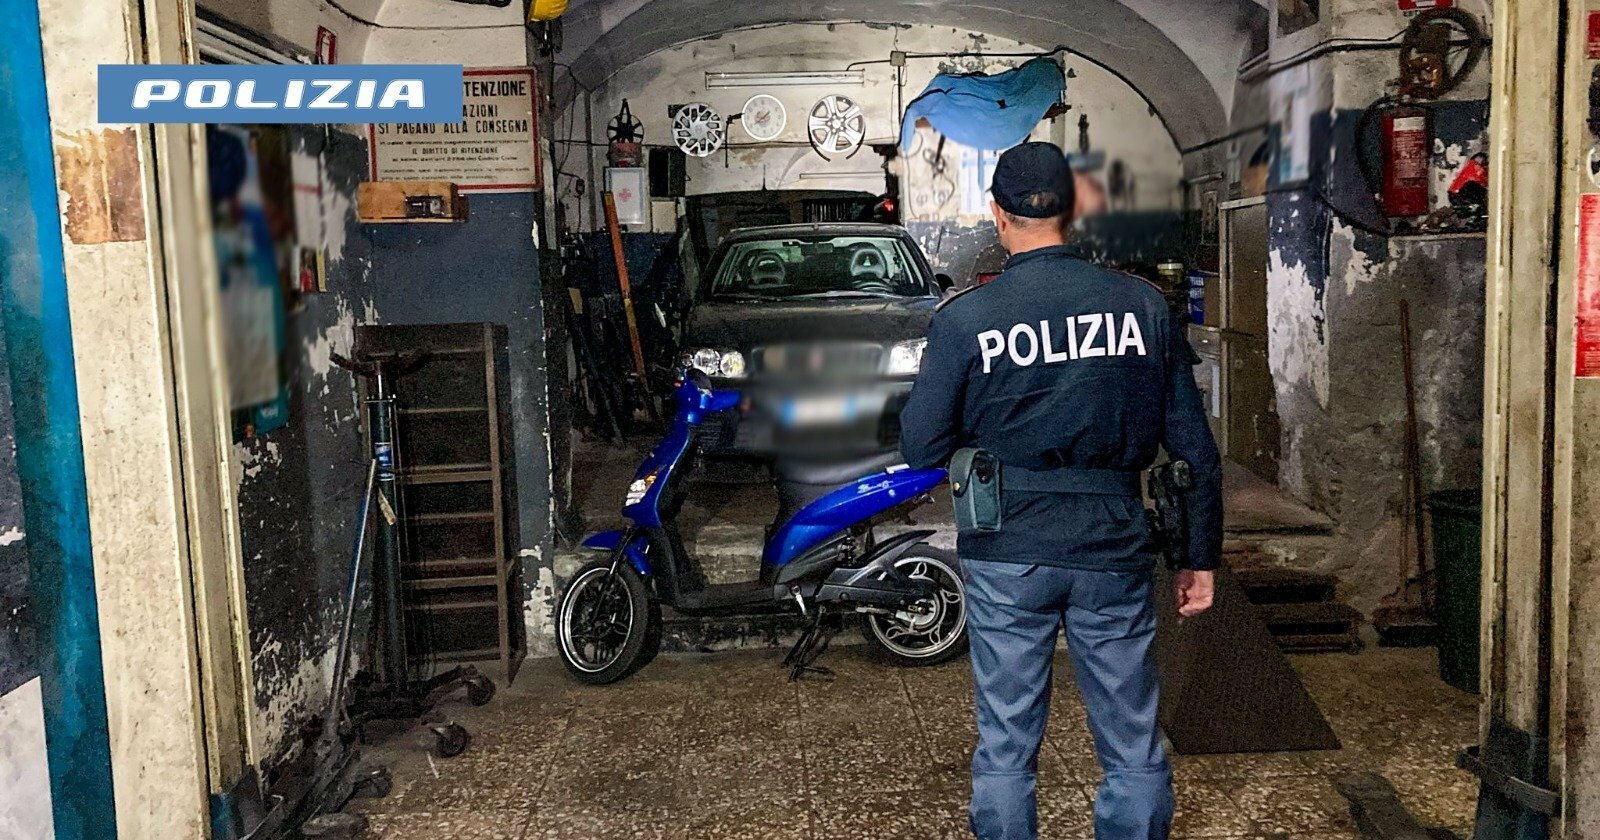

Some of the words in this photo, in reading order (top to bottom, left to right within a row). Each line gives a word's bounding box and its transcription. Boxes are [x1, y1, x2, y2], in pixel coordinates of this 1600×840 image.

[463, 80, 527, 97] TENZIONE
[463, 104, 498, 118] AZIONI
[378, 123, 389, 135] SI
[396, 123, 436, 135] PAGANO
[443, 120, 468, 134] ALLA
[476, 119, 528, 133] CONSEGNA
[461, 146, 498, 154] RITENZIONE
[977, 312, 1147, 374] POLIZIA
